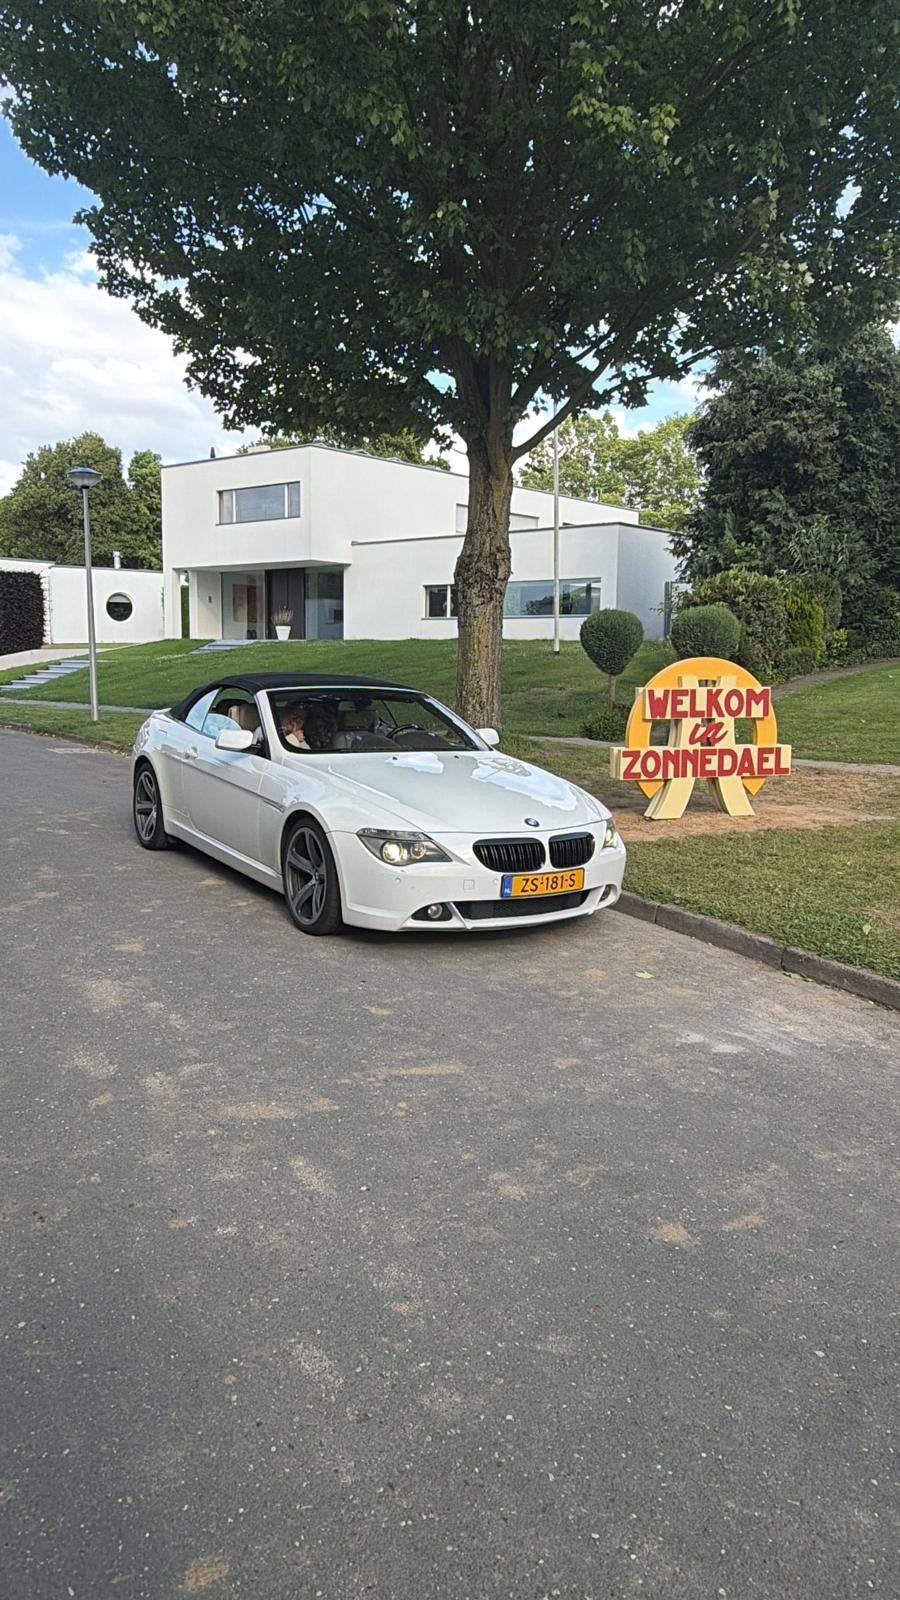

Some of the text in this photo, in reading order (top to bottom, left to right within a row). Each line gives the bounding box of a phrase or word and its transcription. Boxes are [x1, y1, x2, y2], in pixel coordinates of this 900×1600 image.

[648, 688, 770, 719] WELKOM
[688, 721, 728, 745] in
[622, 747, 790, 780] ZONNEDAEL
[520, 873, 576, 893] ZS-181-S
